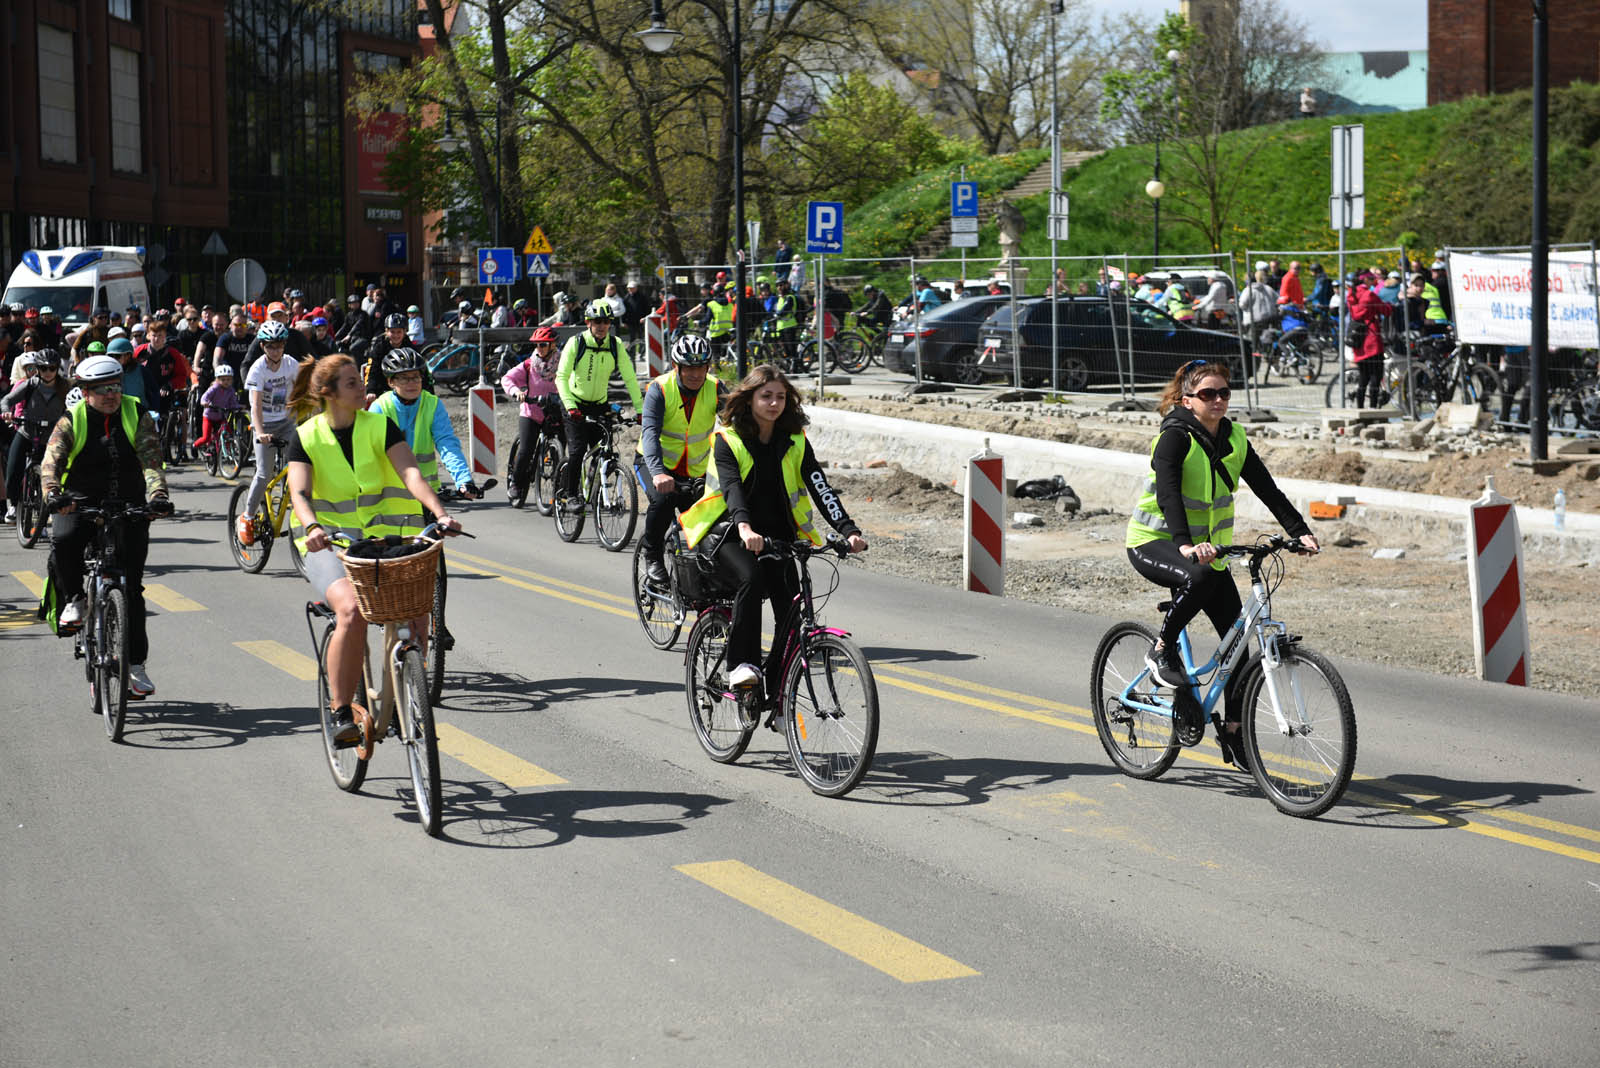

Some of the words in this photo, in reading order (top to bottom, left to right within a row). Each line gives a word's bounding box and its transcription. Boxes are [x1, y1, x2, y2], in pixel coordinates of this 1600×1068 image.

[957, 184, 972, 206] P
[815, 206, 836, 238] P
[393, 240, 402, 254] P
[810, 471, 842, 521] adidas
